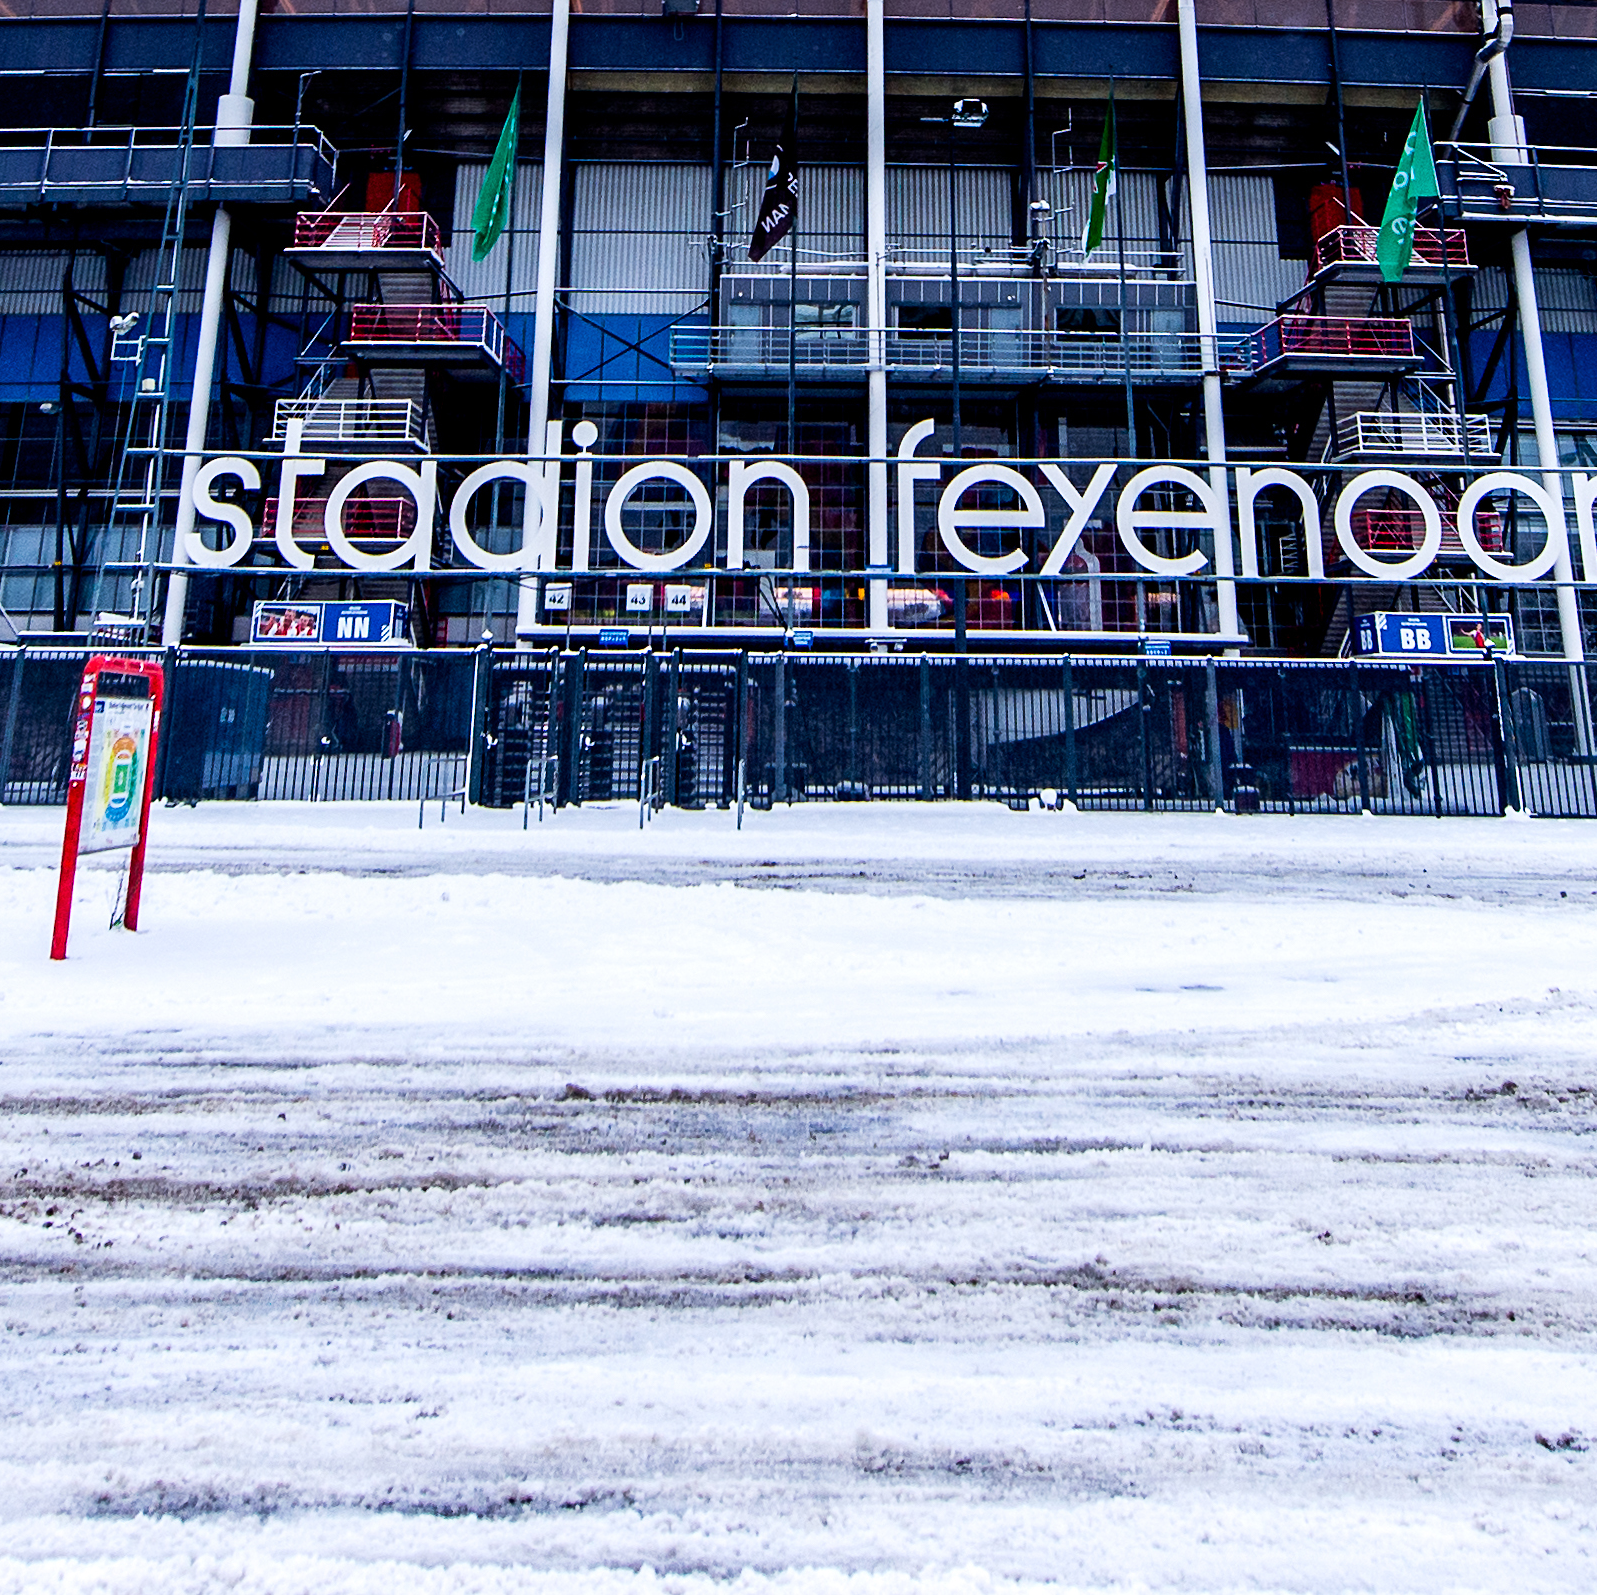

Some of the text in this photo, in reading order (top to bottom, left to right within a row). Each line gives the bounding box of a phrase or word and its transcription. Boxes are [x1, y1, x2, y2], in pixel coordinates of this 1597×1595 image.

[184, 417, 810, 572] stadion
[549, 594, 564, 604] 42
[630, 594, 646, 605] 43
[671, 594, 687, 605] 44
[337, 617, 370, 638] NN
[1400, 628, 1432, 650] BB
